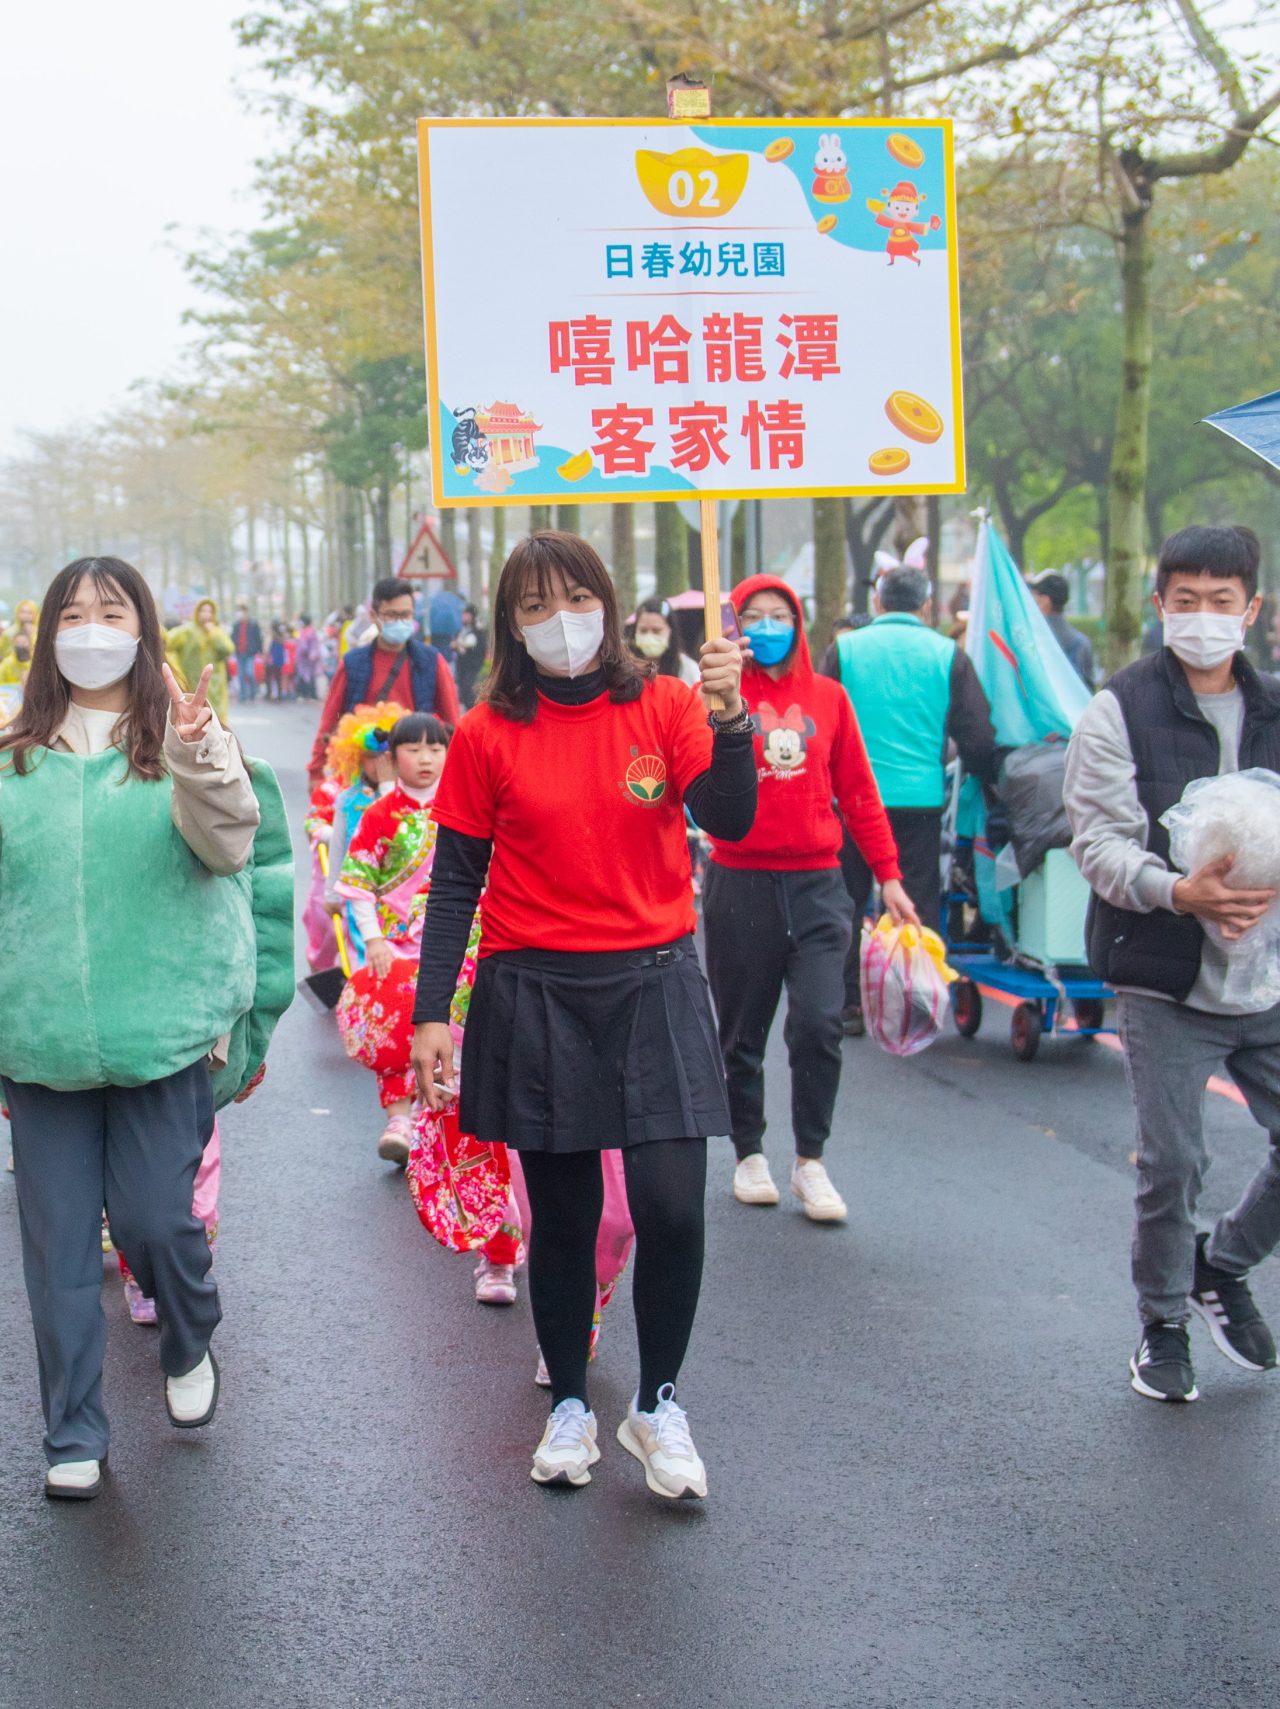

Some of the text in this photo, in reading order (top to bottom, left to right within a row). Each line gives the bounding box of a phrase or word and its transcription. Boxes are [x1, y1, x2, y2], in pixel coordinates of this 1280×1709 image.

[668, 170, 720, 208] 02
[606, 241, 786, 279] 日春幼兒園
[549, 313, 841, 386] 嘻哈龍潭
[591, 400, 806, 474] 客家情
